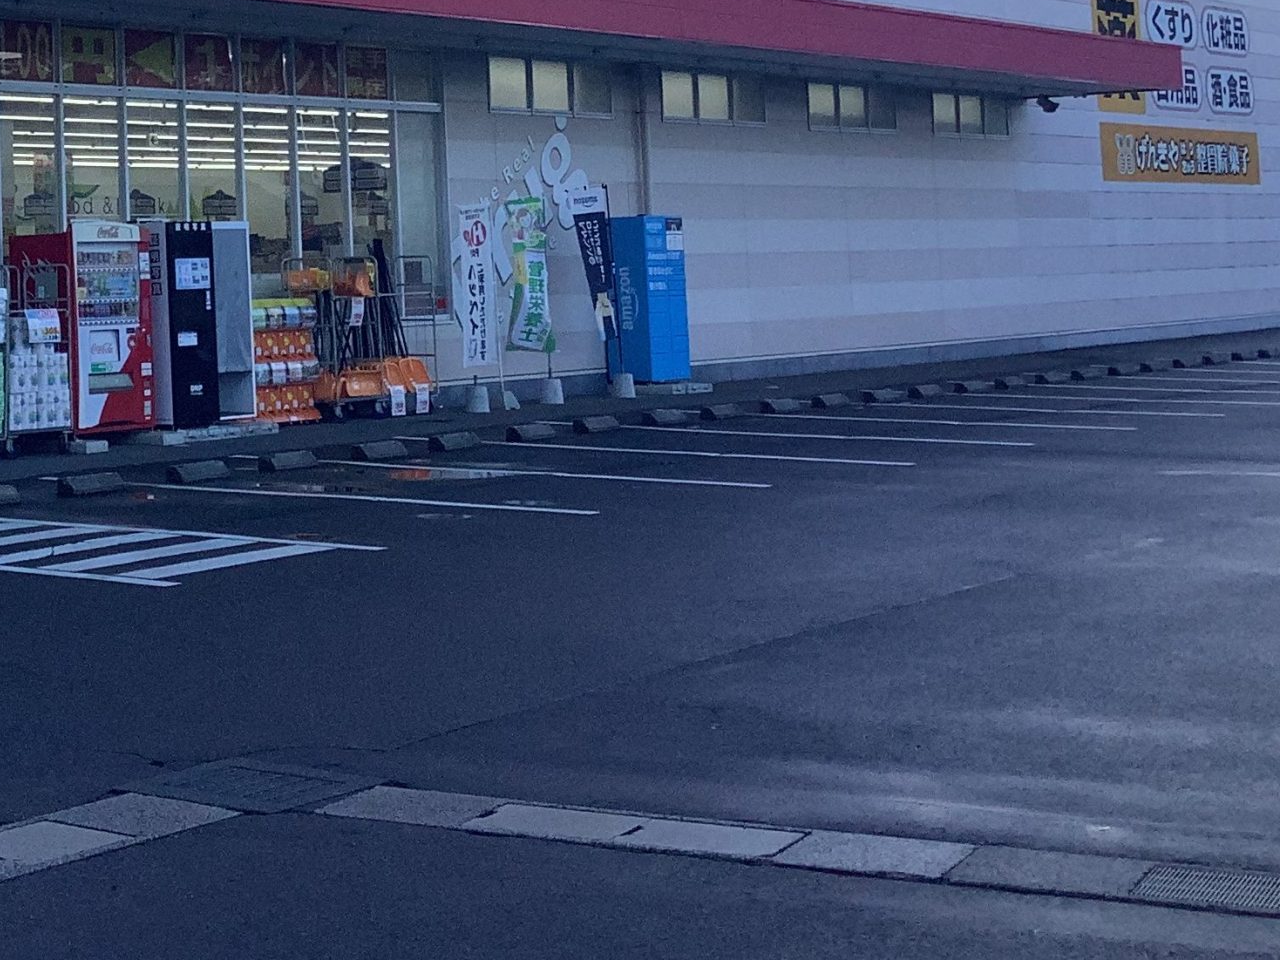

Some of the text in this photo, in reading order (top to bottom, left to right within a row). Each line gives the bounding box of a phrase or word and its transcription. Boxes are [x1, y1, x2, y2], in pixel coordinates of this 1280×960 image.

[1151, 5, 1195, 44] くすり
[1206, 14, 1246, 51] 化粧品
[620, 267, 634, 331] amazon
